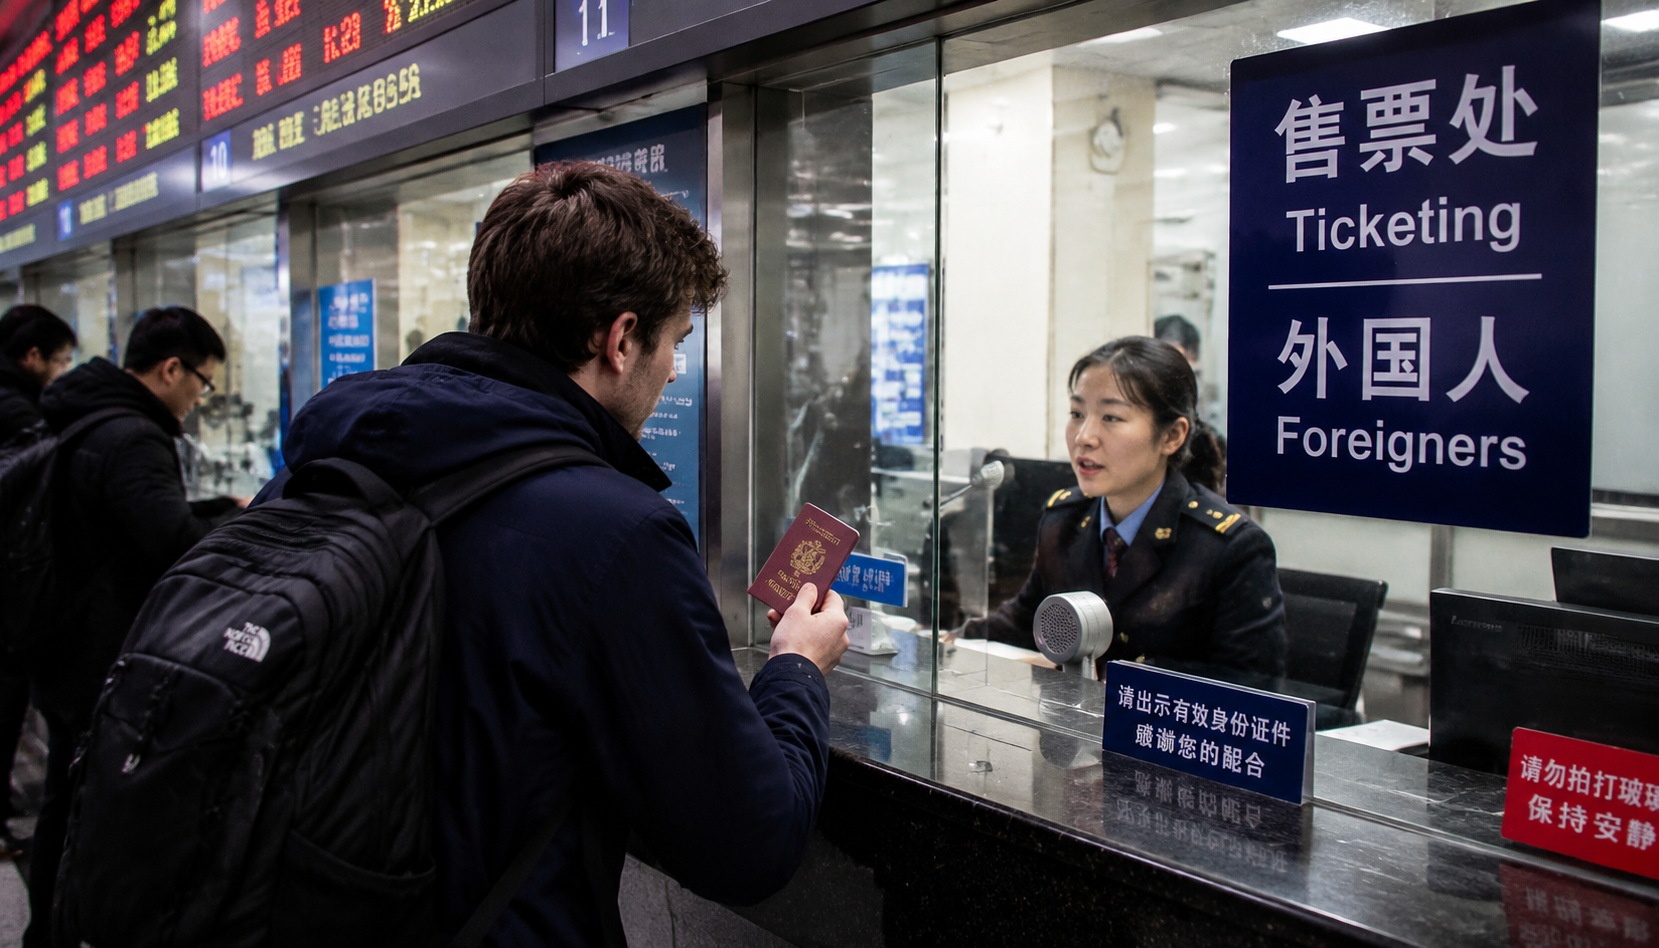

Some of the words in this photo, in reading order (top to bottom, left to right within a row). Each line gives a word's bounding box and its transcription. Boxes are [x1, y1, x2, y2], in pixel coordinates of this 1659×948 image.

[1275, 65, 1538, 184] 售票处
[210, 140, 228, 180] 10
[1285, 196, 1521, 253] Ticketing
[1277, 315, 1530, 404] 外国人
[1277, 415, 1527, 473] Foreigners
[1118, 684, 1291, 747] 请出示有效身份证件
[1528, 793, 1656, 850] 保持安静
